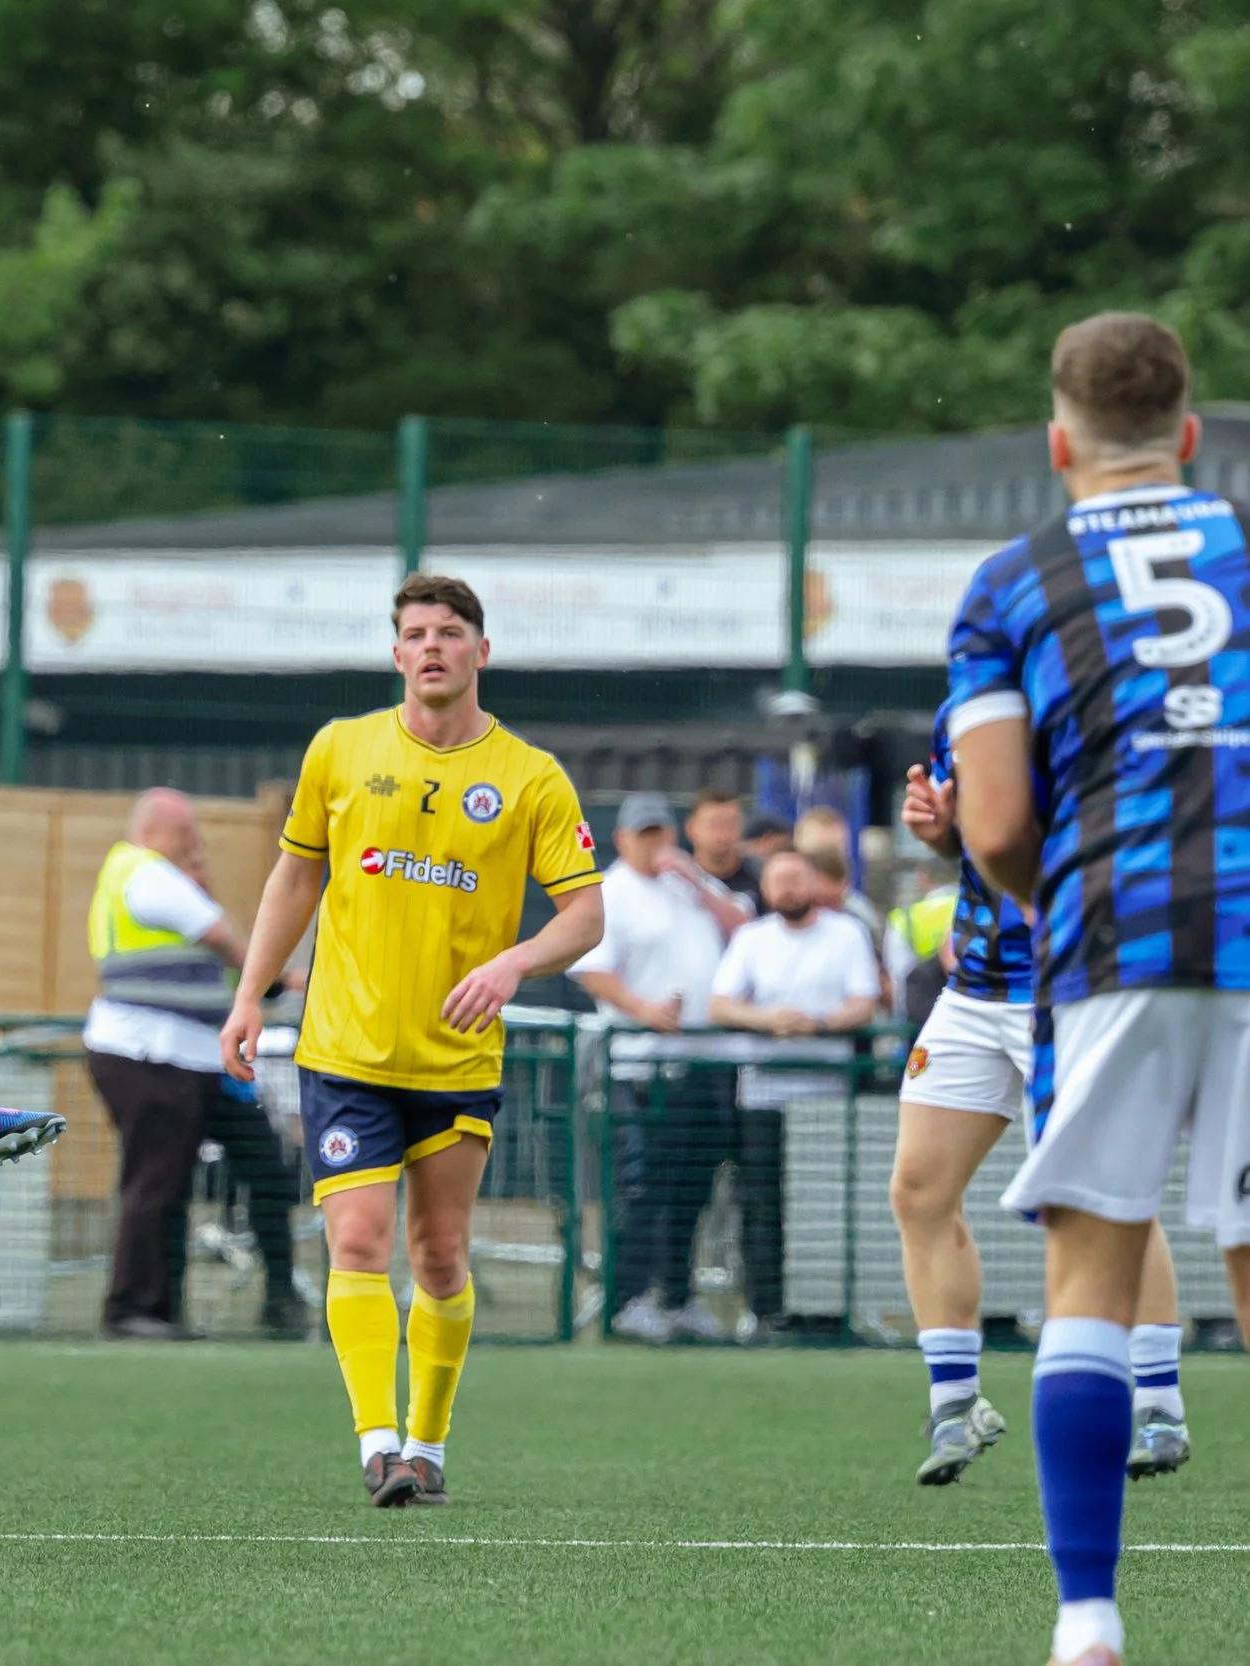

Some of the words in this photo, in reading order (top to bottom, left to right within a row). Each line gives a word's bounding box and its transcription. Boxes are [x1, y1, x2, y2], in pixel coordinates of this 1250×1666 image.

[1107, 530, 1233, 667] 5
[421, 780, 440, 814] 2
[384, 849, 478, 892] Fidelis
